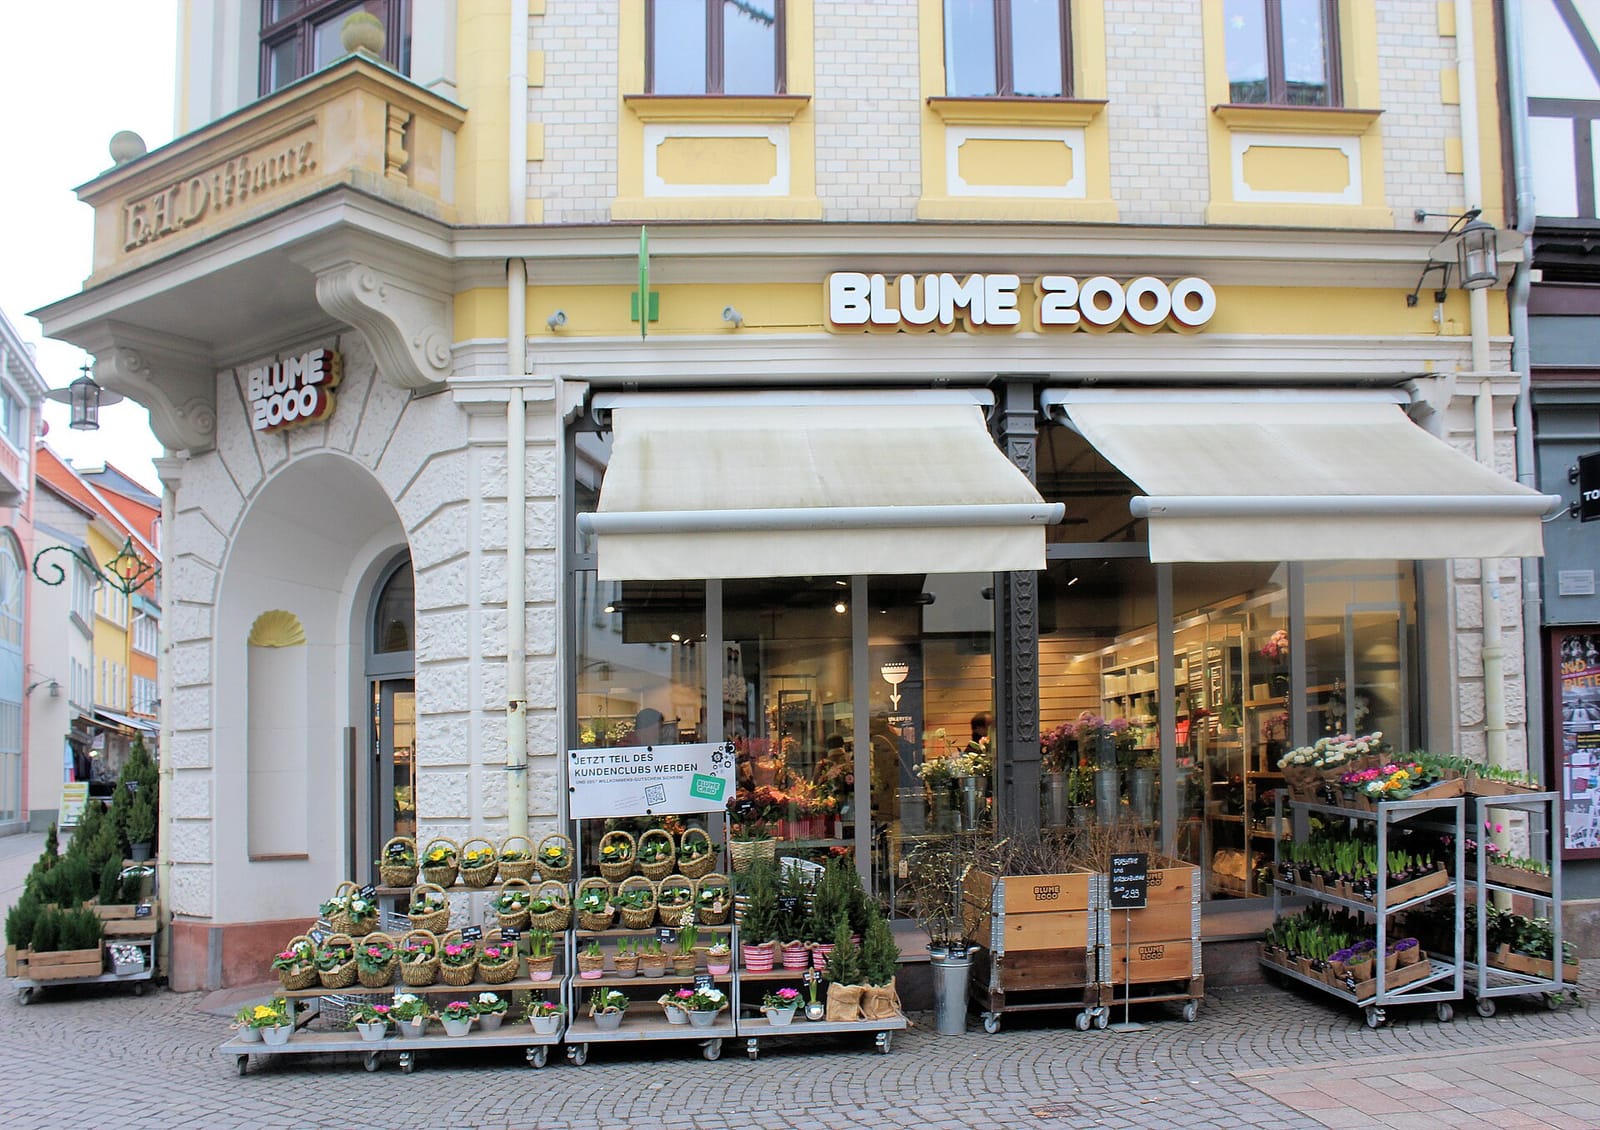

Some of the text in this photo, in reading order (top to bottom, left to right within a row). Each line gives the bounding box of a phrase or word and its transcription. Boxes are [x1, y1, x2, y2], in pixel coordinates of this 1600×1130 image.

[829, 271, 1217, 327] BLUME 2000
[247, 348, 326, 402] BLUME
[252, 384, 320, 431] 2000
[574, 753, 654, 765] JETZT TEIL DES
[574, 763, 698, 777] KUNDENCLUBS WERDEN
[697, 780, 719, 789] BLUME
[697, 786, 716, 794] CARD
[1146, 871, 1163, 880] UME
[1034, 885, 1060, 894] BLUME
[1139, 945, 1164, 954] BLUME
[1141, 952, 1163, 960] 2000
